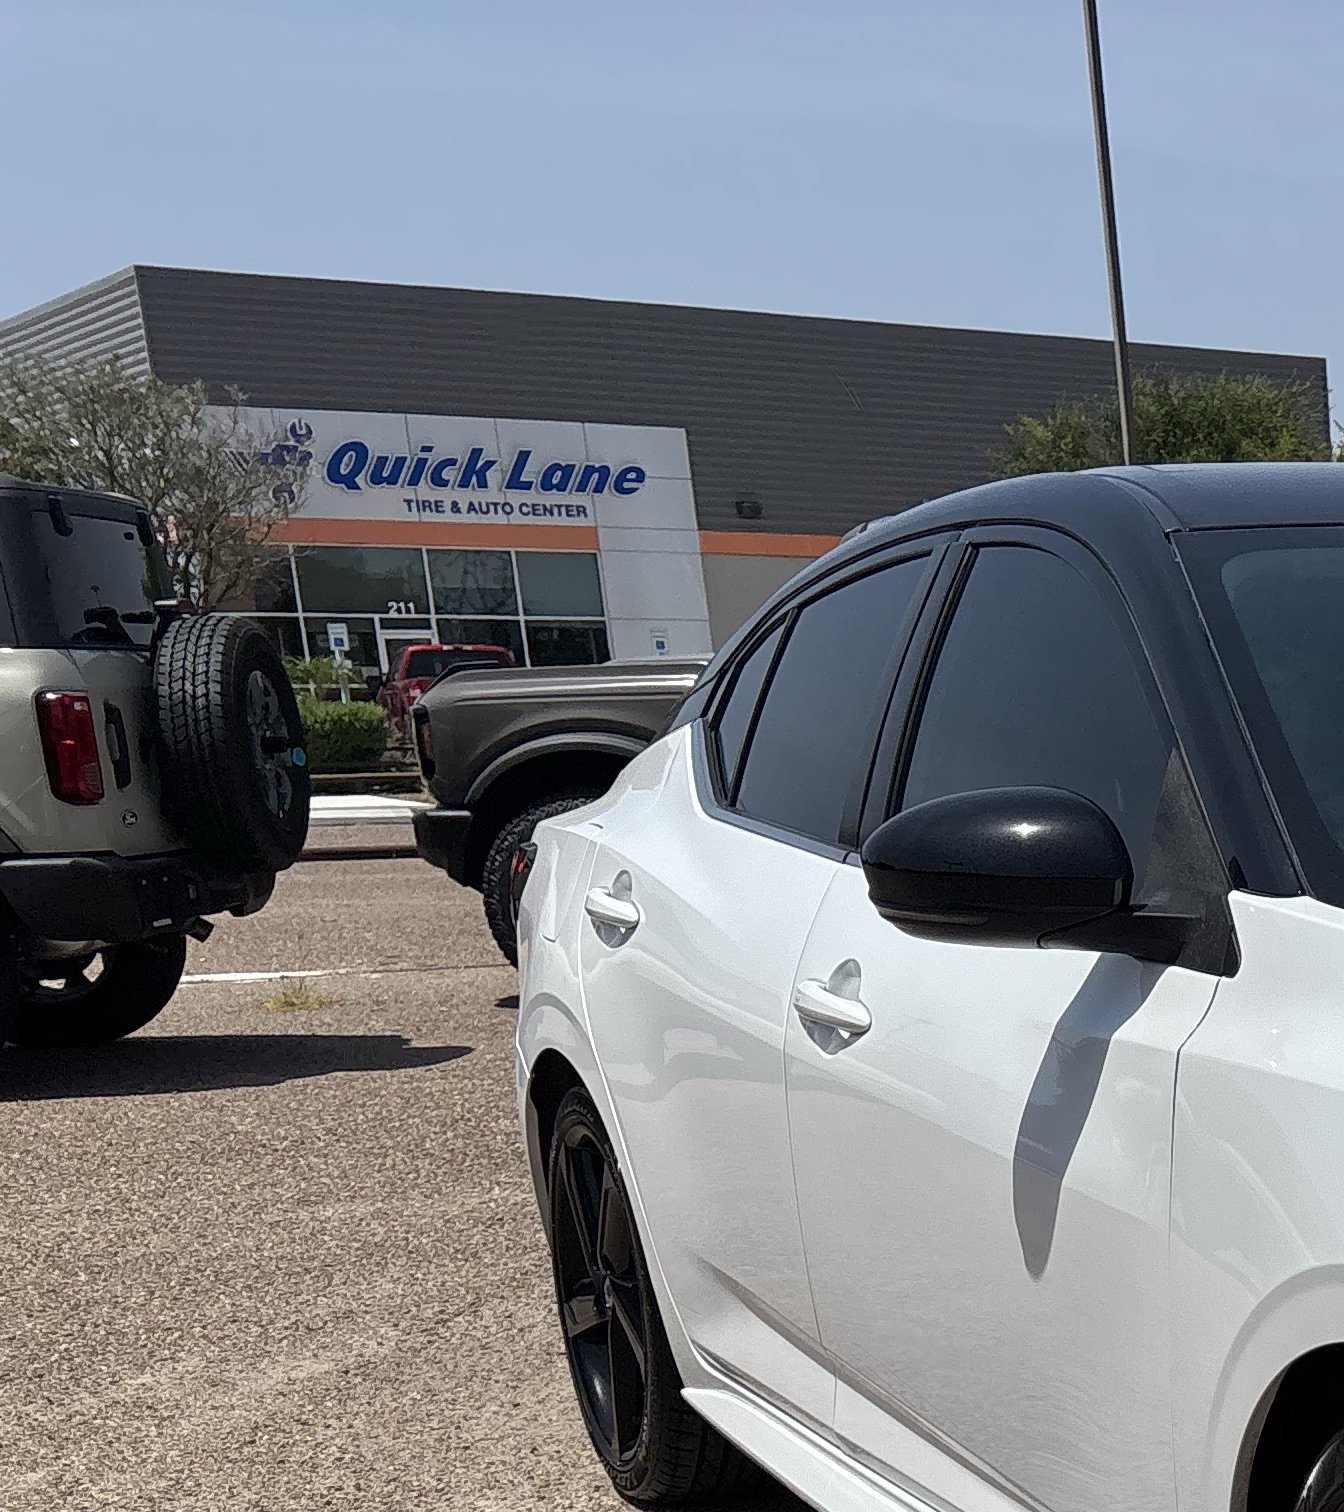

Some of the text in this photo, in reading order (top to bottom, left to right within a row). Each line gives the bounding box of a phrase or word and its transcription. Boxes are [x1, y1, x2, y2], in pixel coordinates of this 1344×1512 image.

[326, 440, 647, 495] Quick Lane
[403, 498, 589, 519] TIRE & AUTO CENTER
[387, 601, 416, 615] 211
